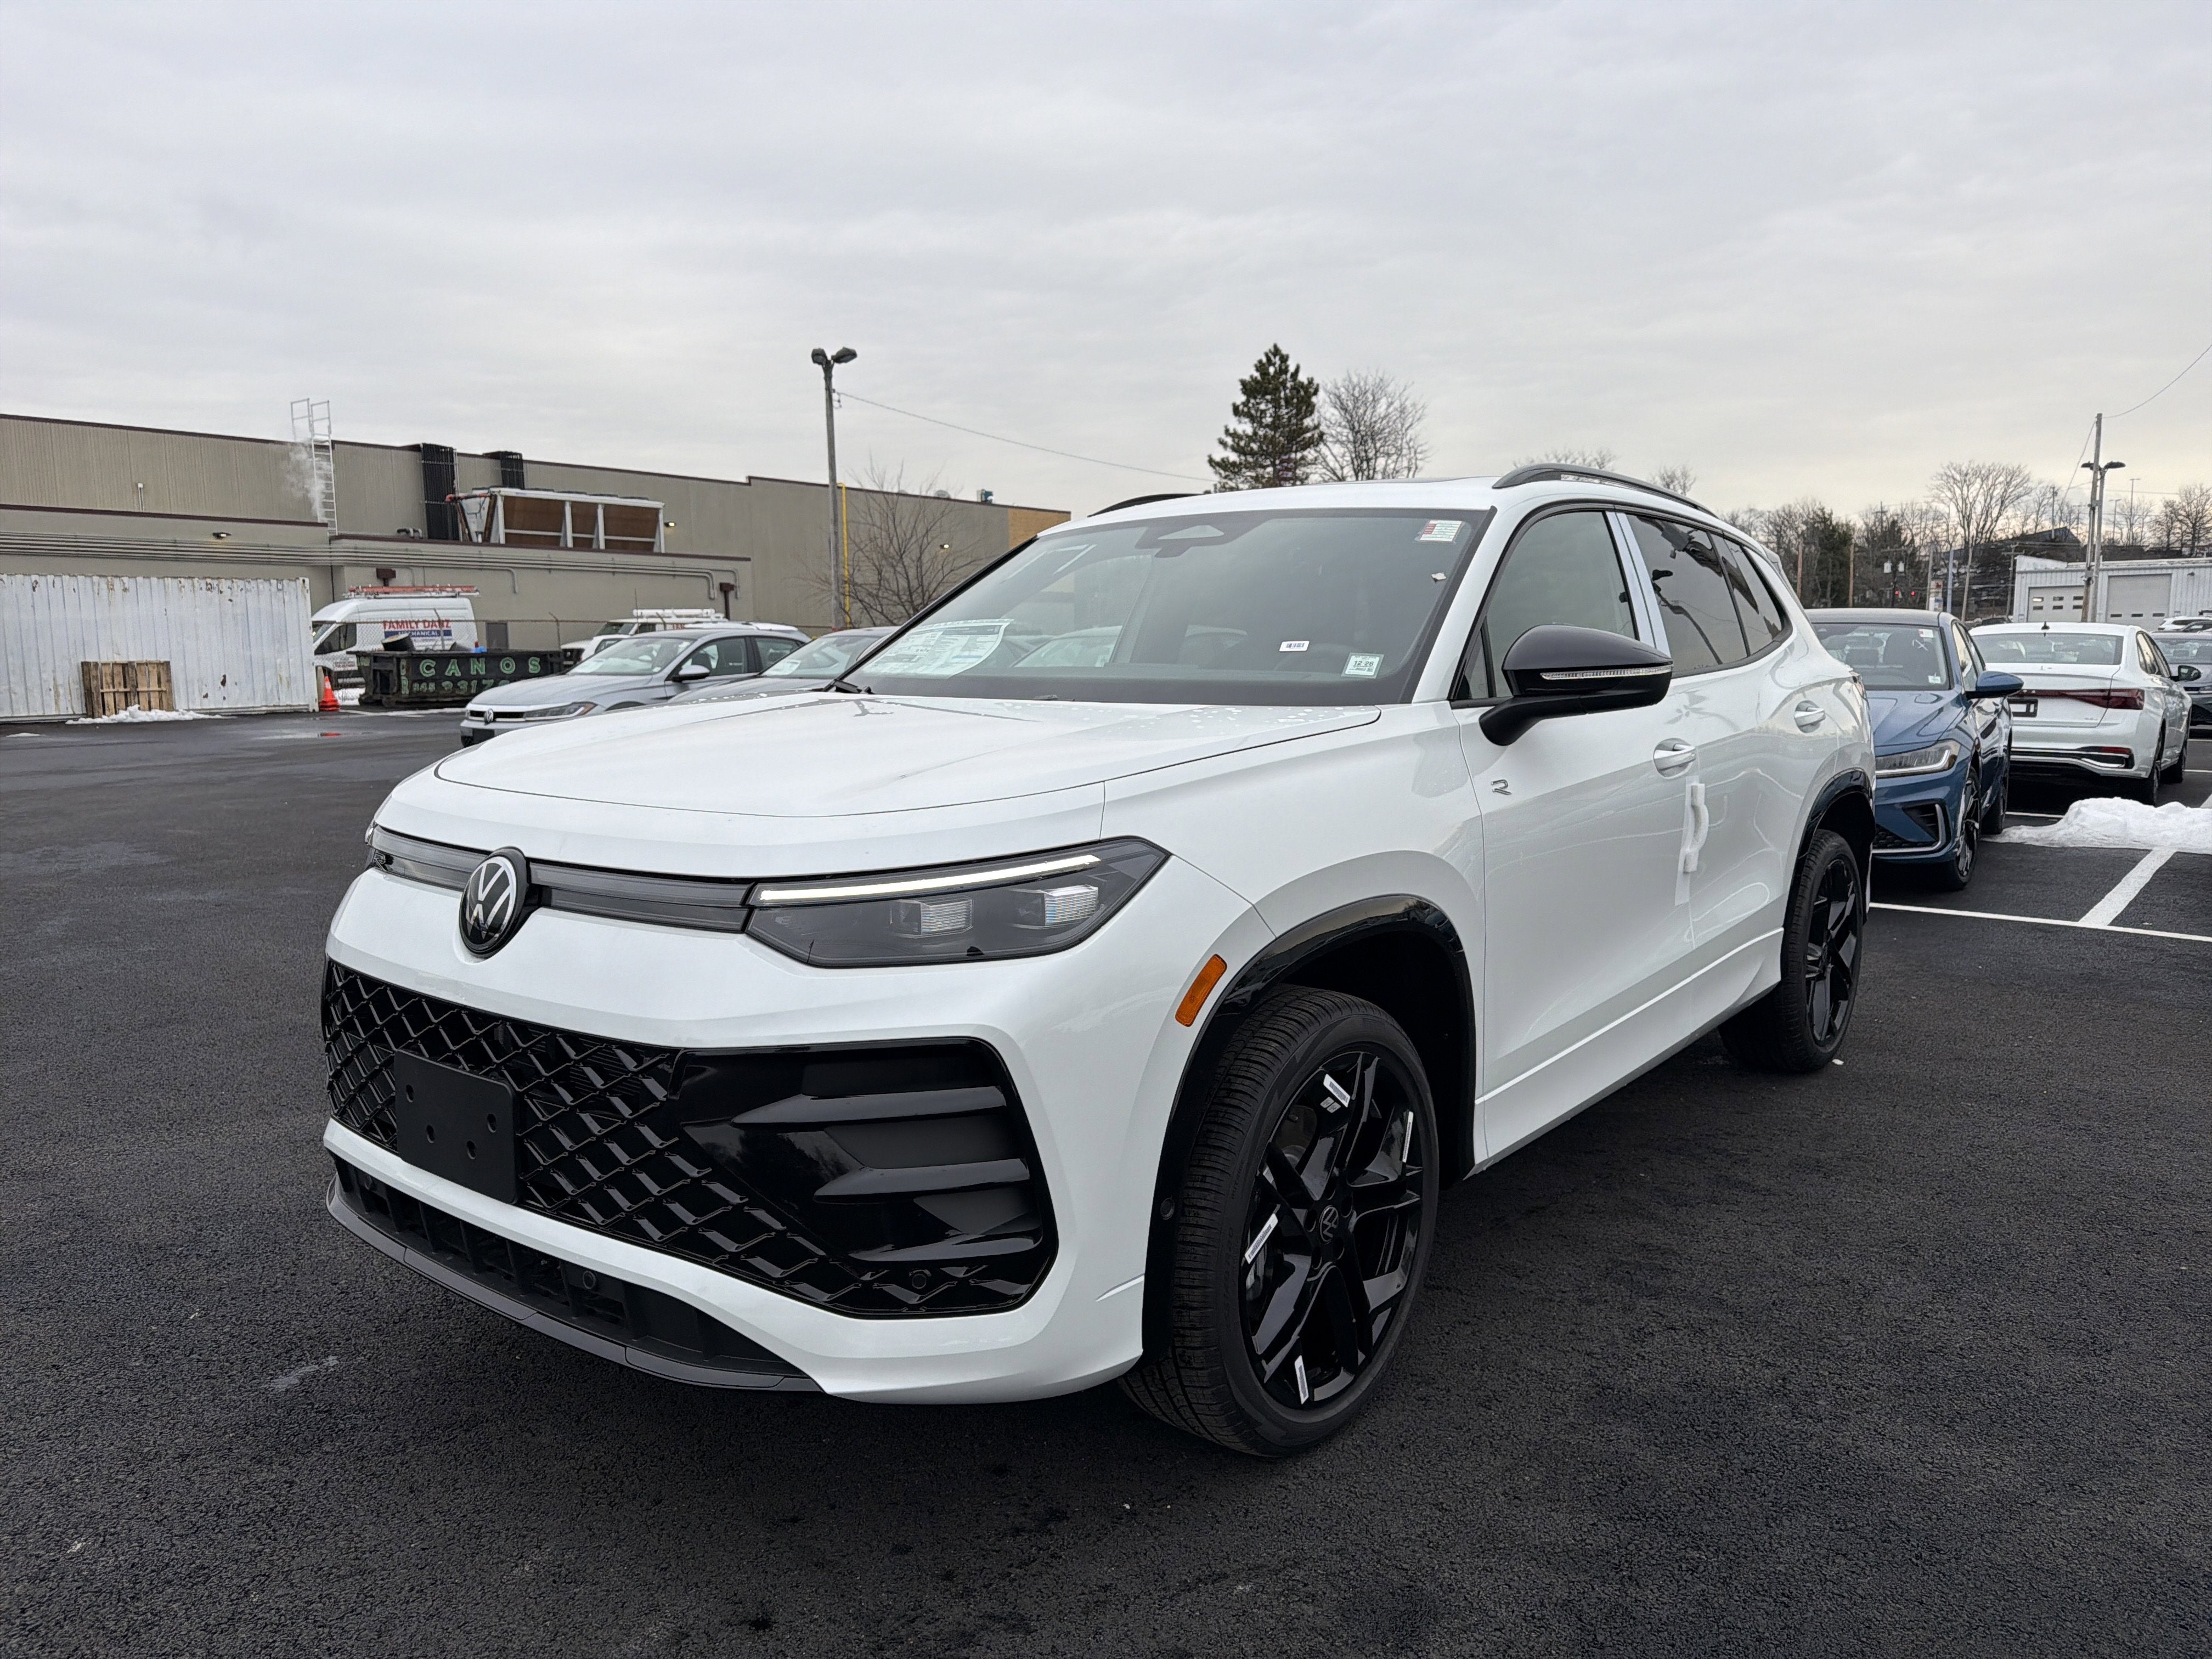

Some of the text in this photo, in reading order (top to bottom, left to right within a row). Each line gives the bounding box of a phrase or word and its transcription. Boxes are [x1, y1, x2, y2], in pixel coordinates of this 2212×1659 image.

[383, 620, 419, 629] FAMILY
[420, 657, 541, 678] CANOS
[1491, 779, 1513, 795] R
[466, 856, 517, 945] VW
